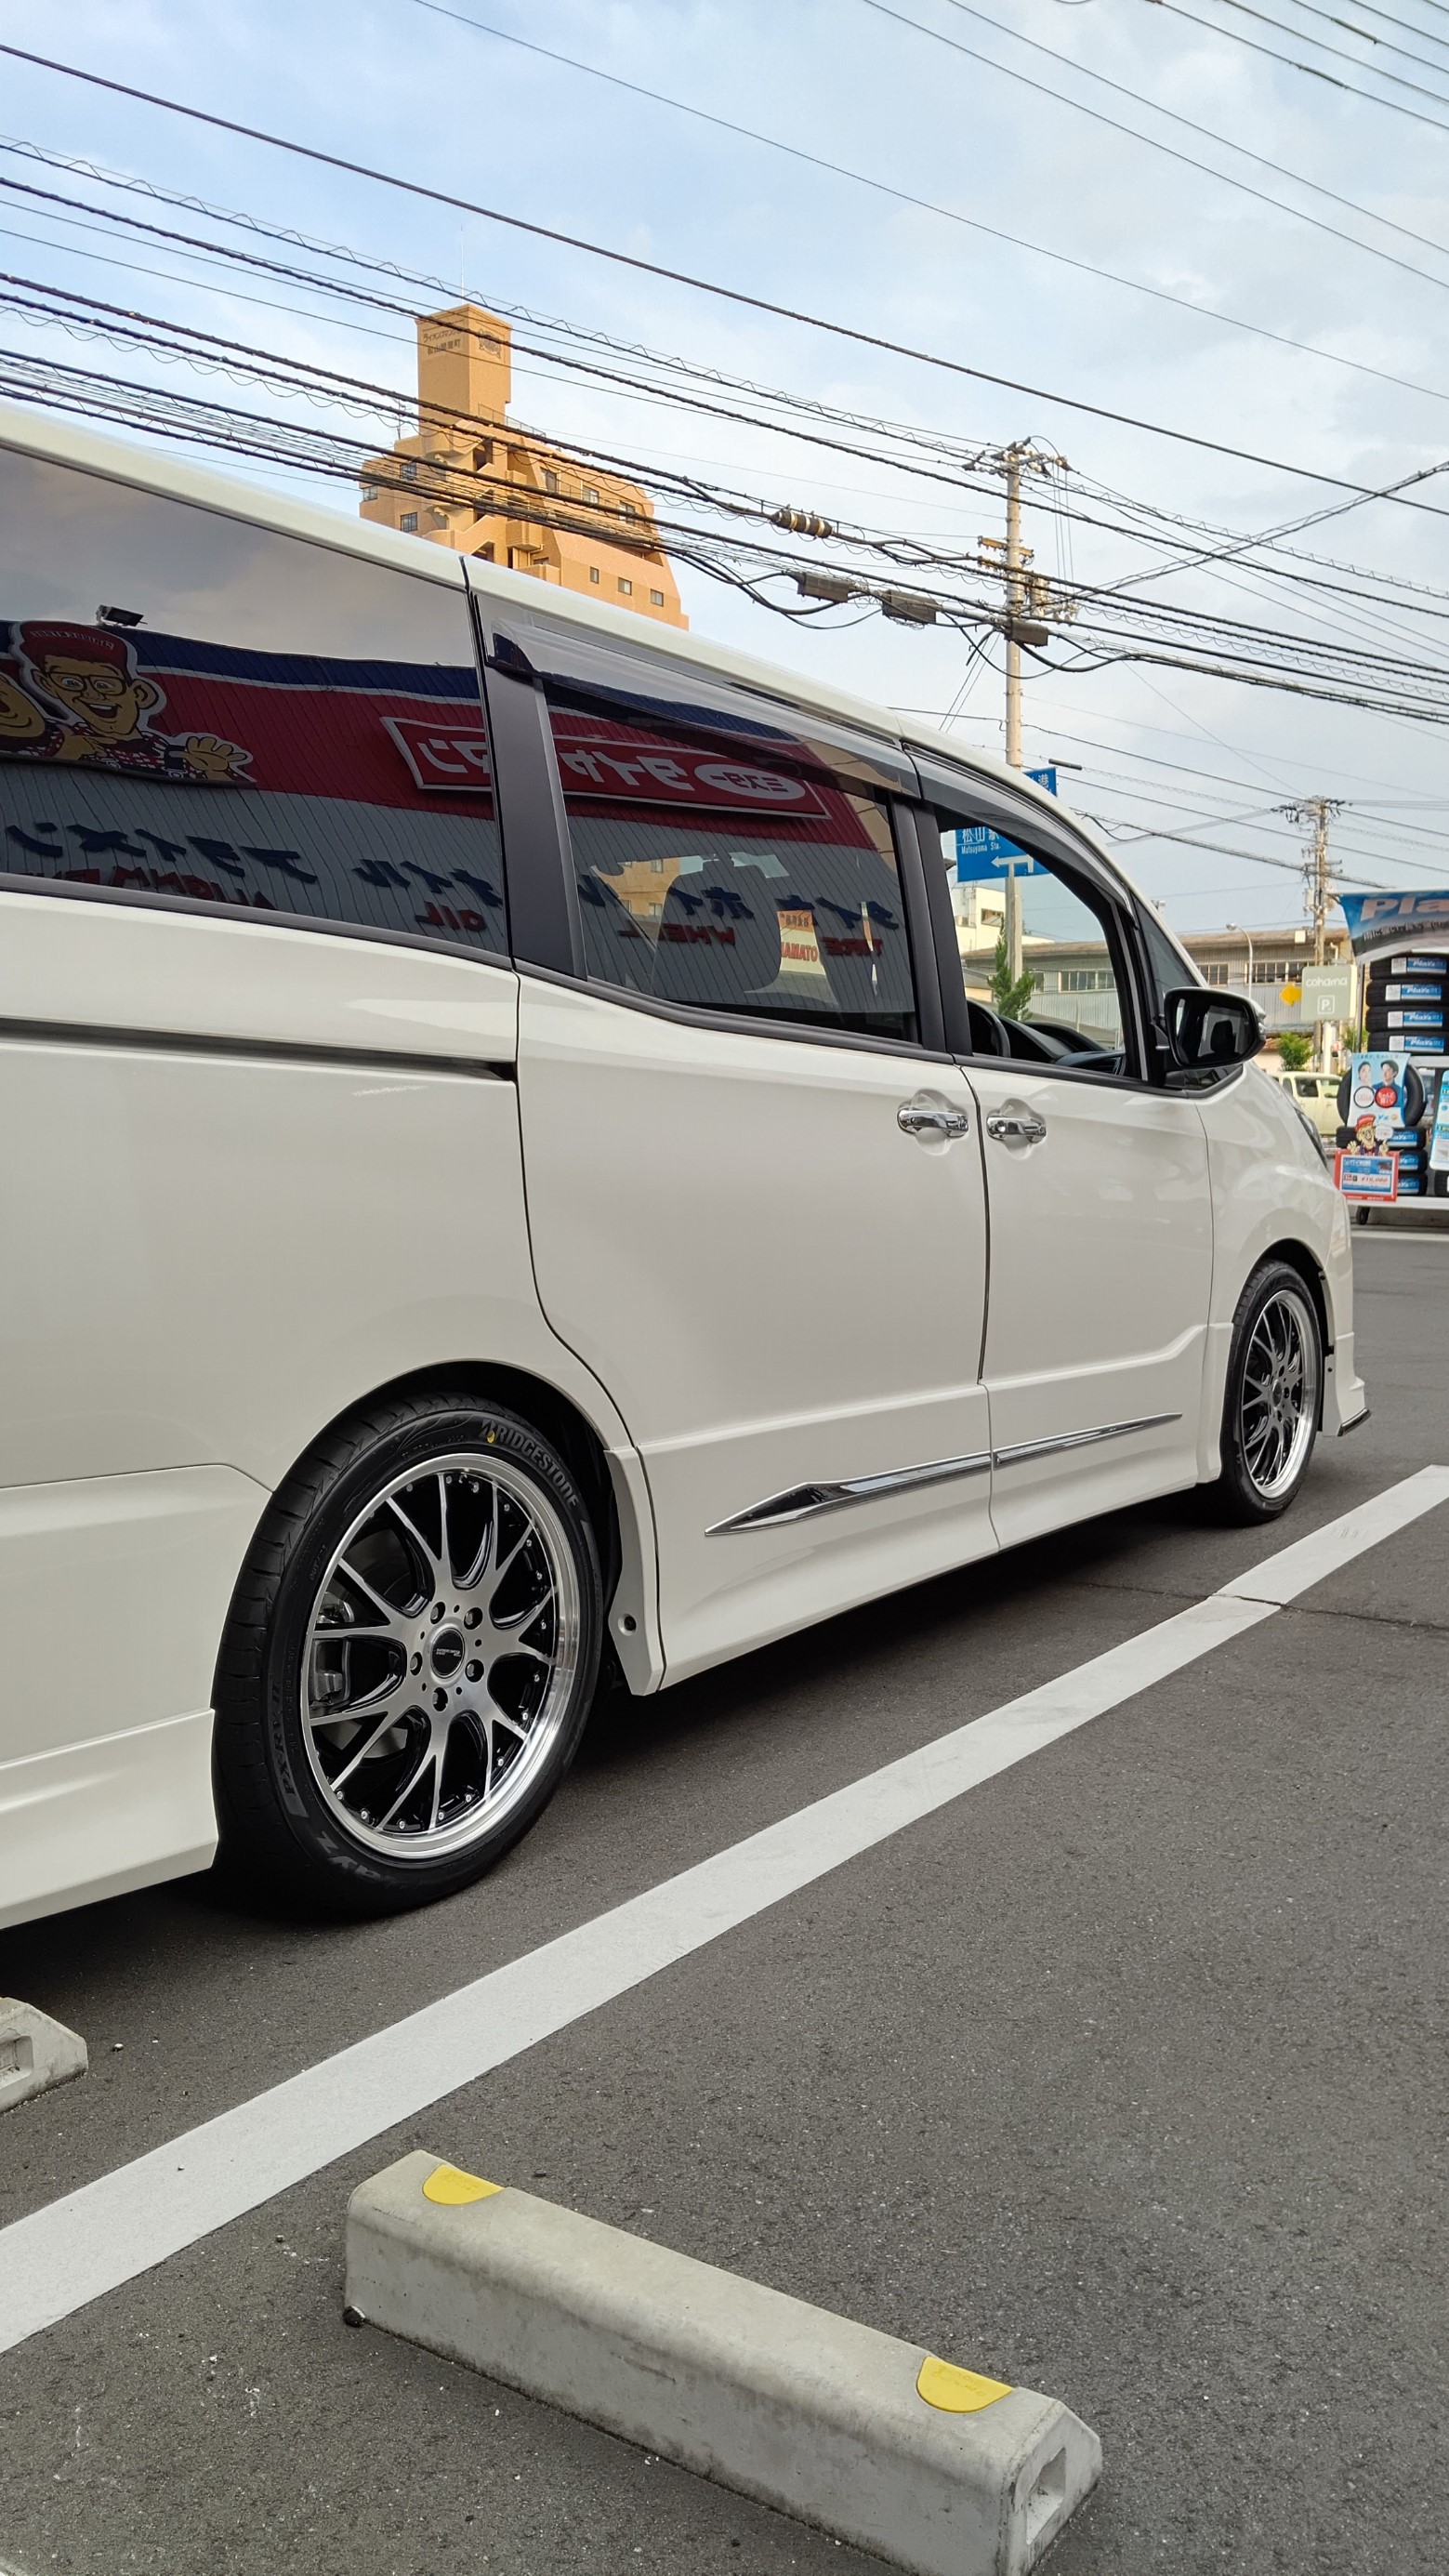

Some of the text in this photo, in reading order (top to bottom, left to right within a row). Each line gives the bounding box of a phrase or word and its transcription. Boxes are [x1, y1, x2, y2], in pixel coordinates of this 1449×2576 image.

[961, 844, 988, 854] Matsuyama
[1306, 976, 1348, 986] cohama
[478, 1419, 579, 1510] BRIDGESTONE
